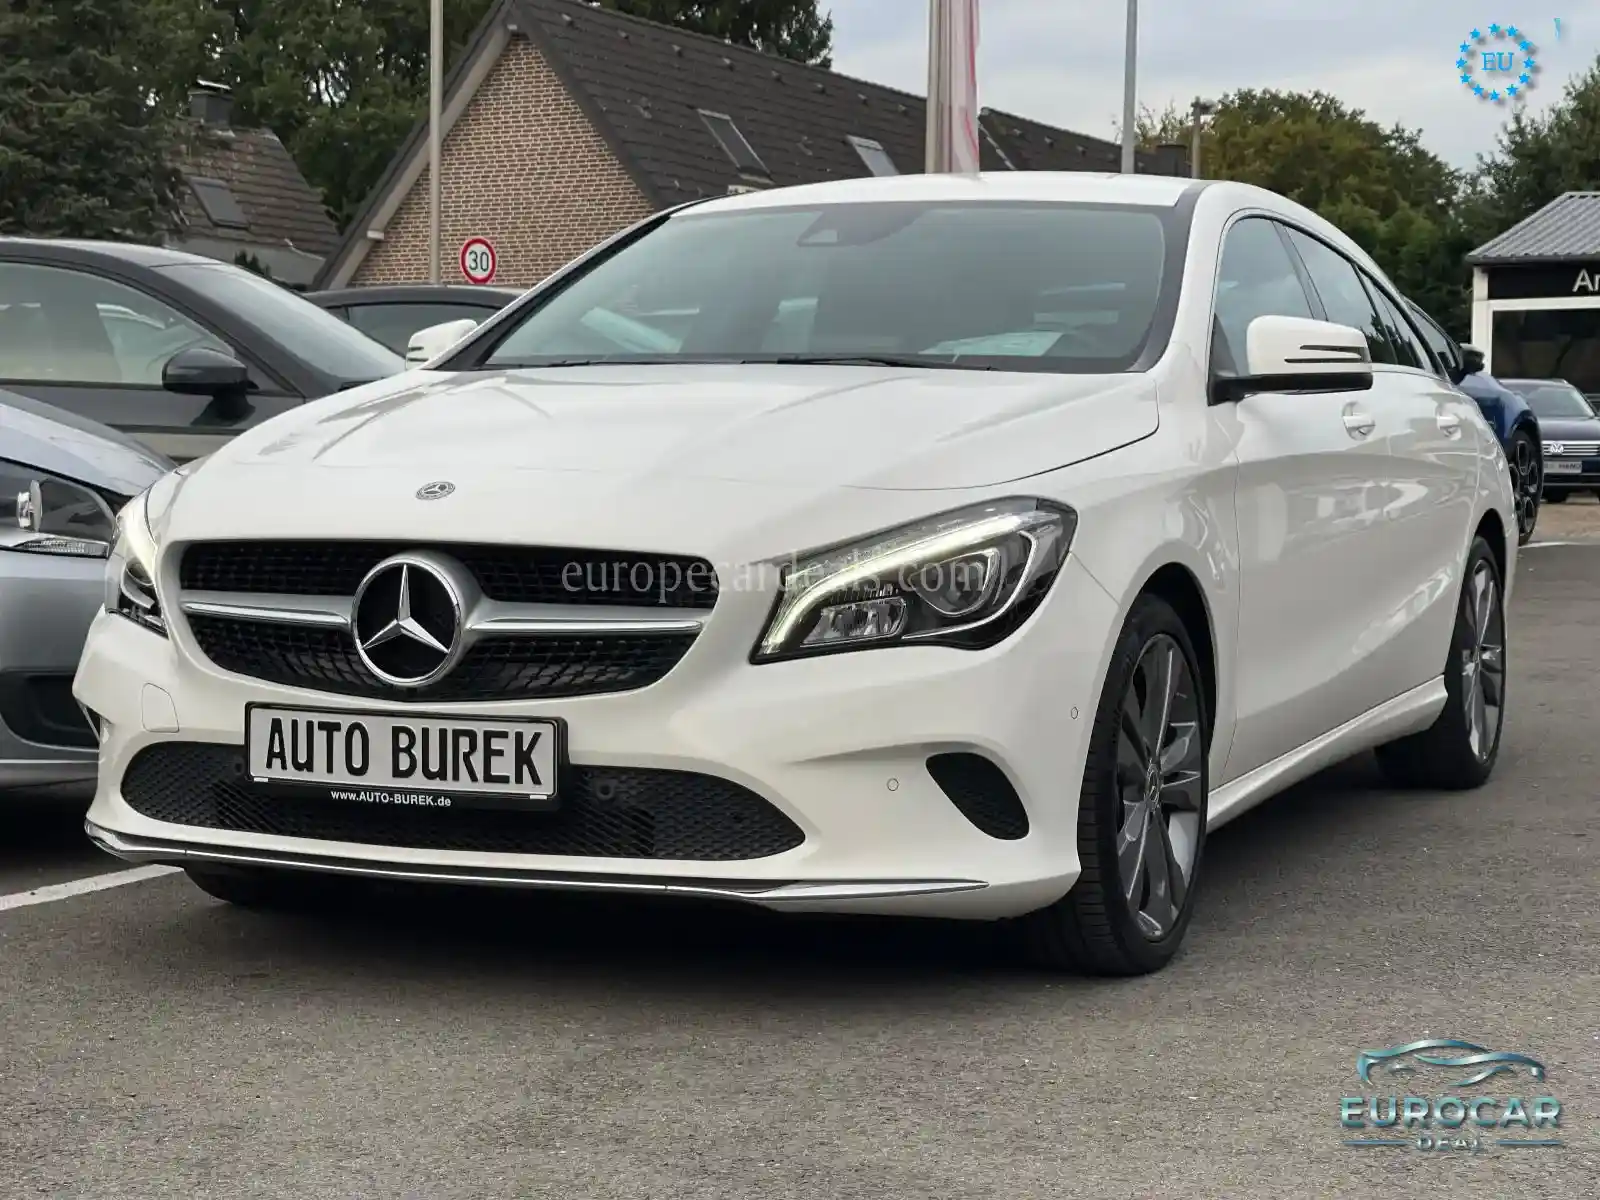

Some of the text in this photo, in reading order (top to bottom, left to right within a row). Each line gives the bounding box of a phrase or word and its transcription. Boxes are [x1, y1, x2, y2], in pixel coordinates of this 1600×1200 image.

[469, 250, 489, 272] 30
[266, 717, 543, 785] AUTO BUREK
[330, 790, 452, 807] www.AUTO-BUREK.de
